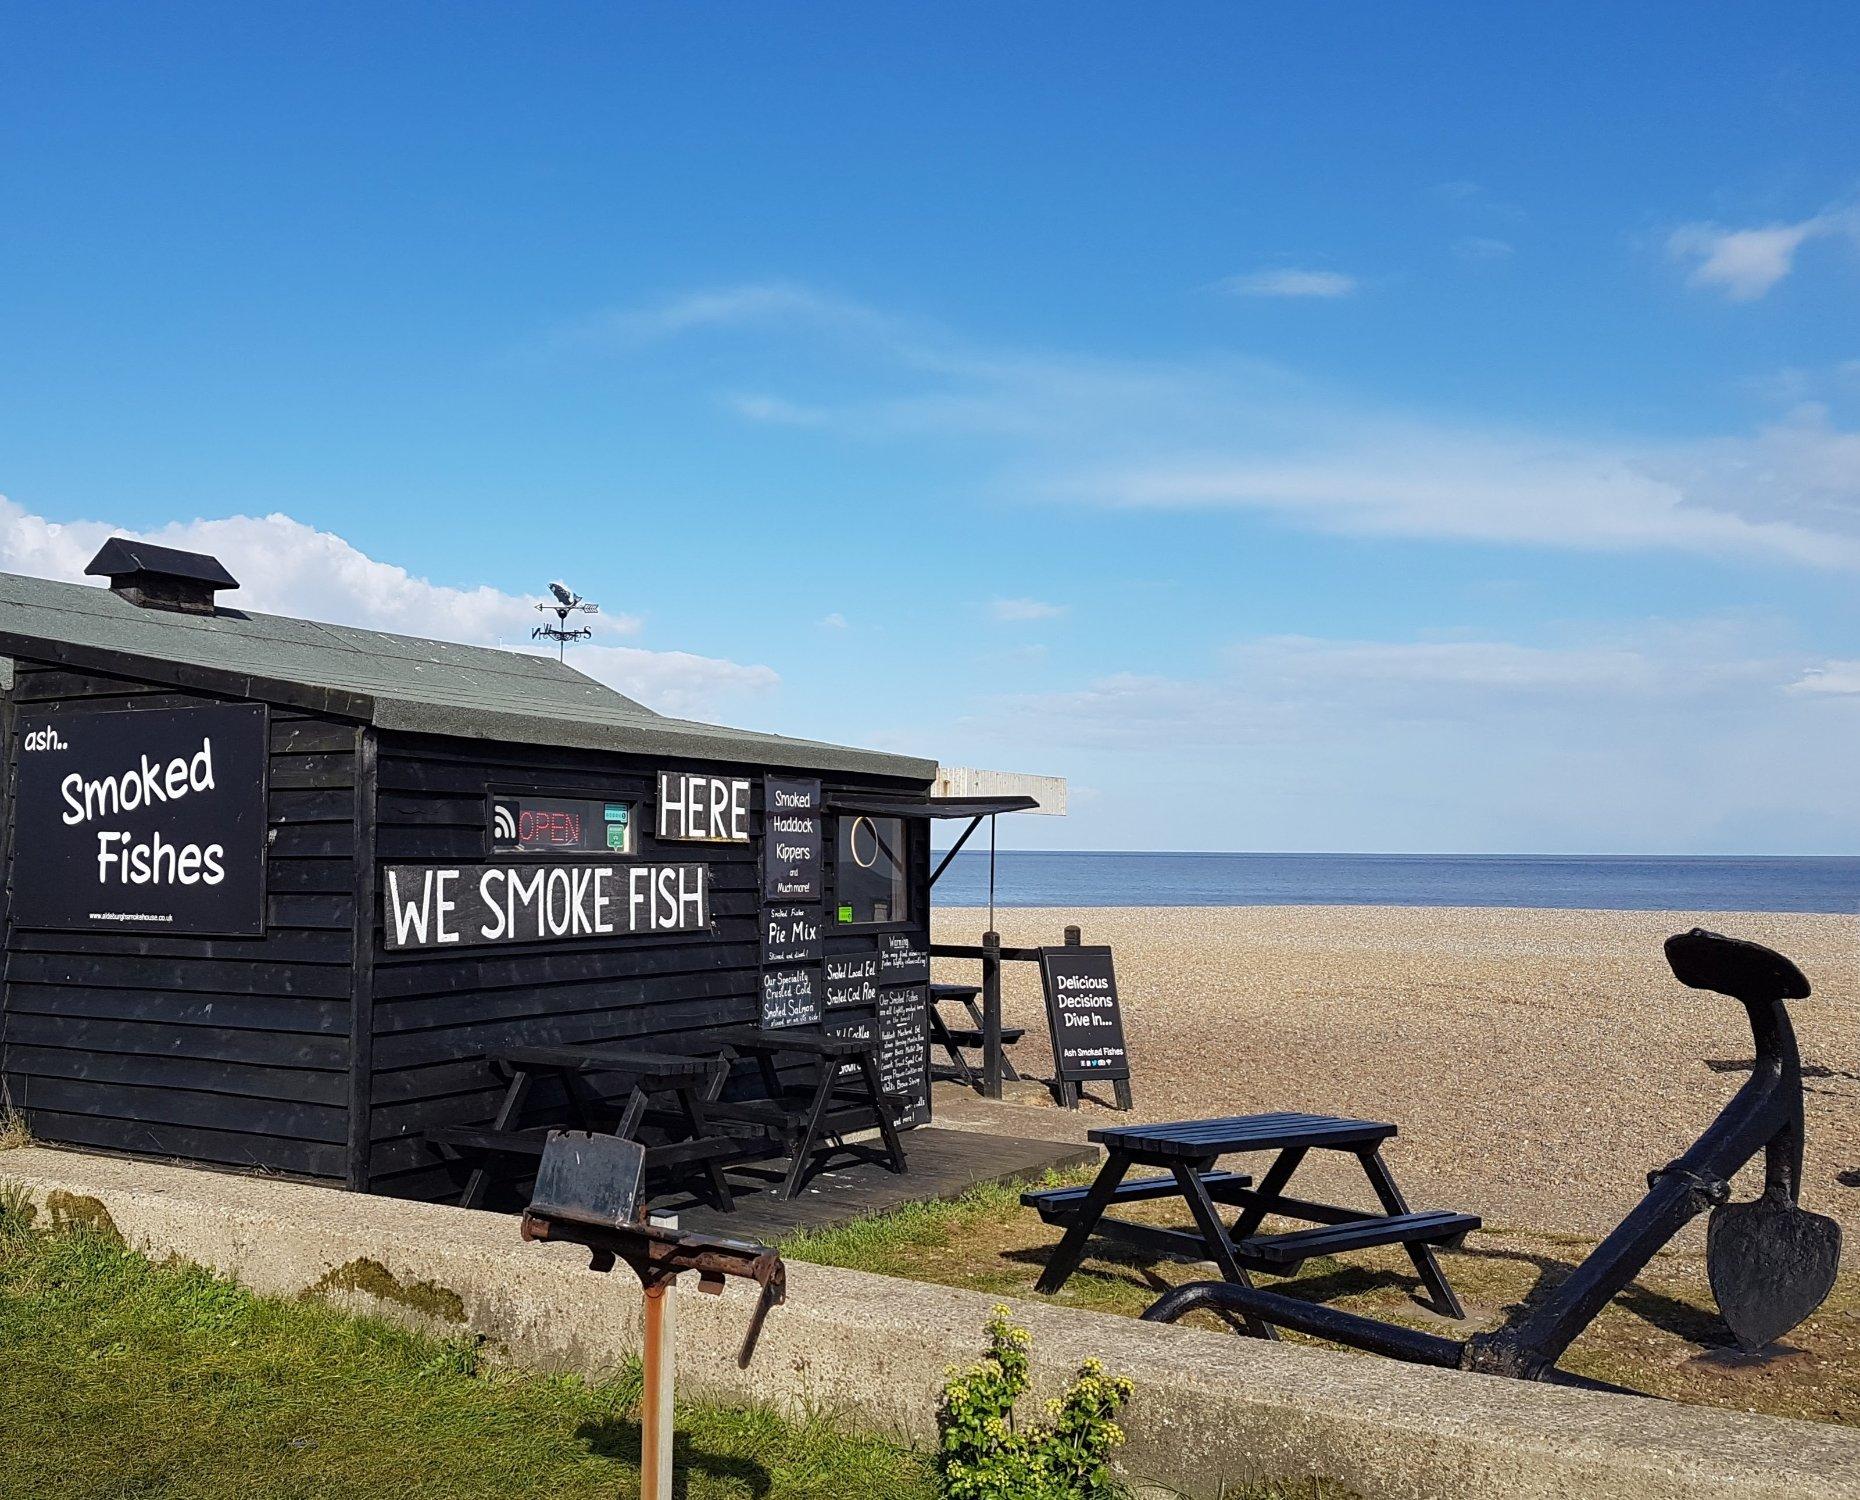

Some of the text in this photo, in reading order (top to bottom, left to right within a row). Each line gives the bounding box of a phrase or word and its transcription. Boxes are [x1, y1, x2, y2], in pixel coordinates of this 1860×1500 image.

[583, 625, 592, 640] S
[24, 725, 68, 751] ash..
[61, 737, 215, 826] Smoked
[661, 775, 750, 839] HERE
[775, 790, 811, 808] Smoked
[518, 811, 580, 843] OPEN
[773, 815, 813, 834] Haddock
[97, 831, 226, 886] Fishes
[776, 842, 811, 863] Kippers
[789, 869, 799, 878] and
[777, 883, 810, 893] Much more!
[388, 866, 704, 945] WE SMOKE FISH
[768, 921, 817, 944] Pie Mix
[764, 970, 809, 987] Our Speciality
[827, 963, 847, 981] Smoked
[848, 961, 863, 978] Local
[865, 960, 876, 977] Eel
[1057, 975, 1109, 990] Delicious
[827, 981, 876, 1006] Smoked Cod Roe
[1057, 994, 1114, 1009] Decisions
[764, 1003, 787, 1020] Smoked
[788, 998, 814, 1016] Salmon
[1064, 1013, 1090, 1027] Dive
[1064, 1047, 1124, 1058] Ash Smoked Fishes
